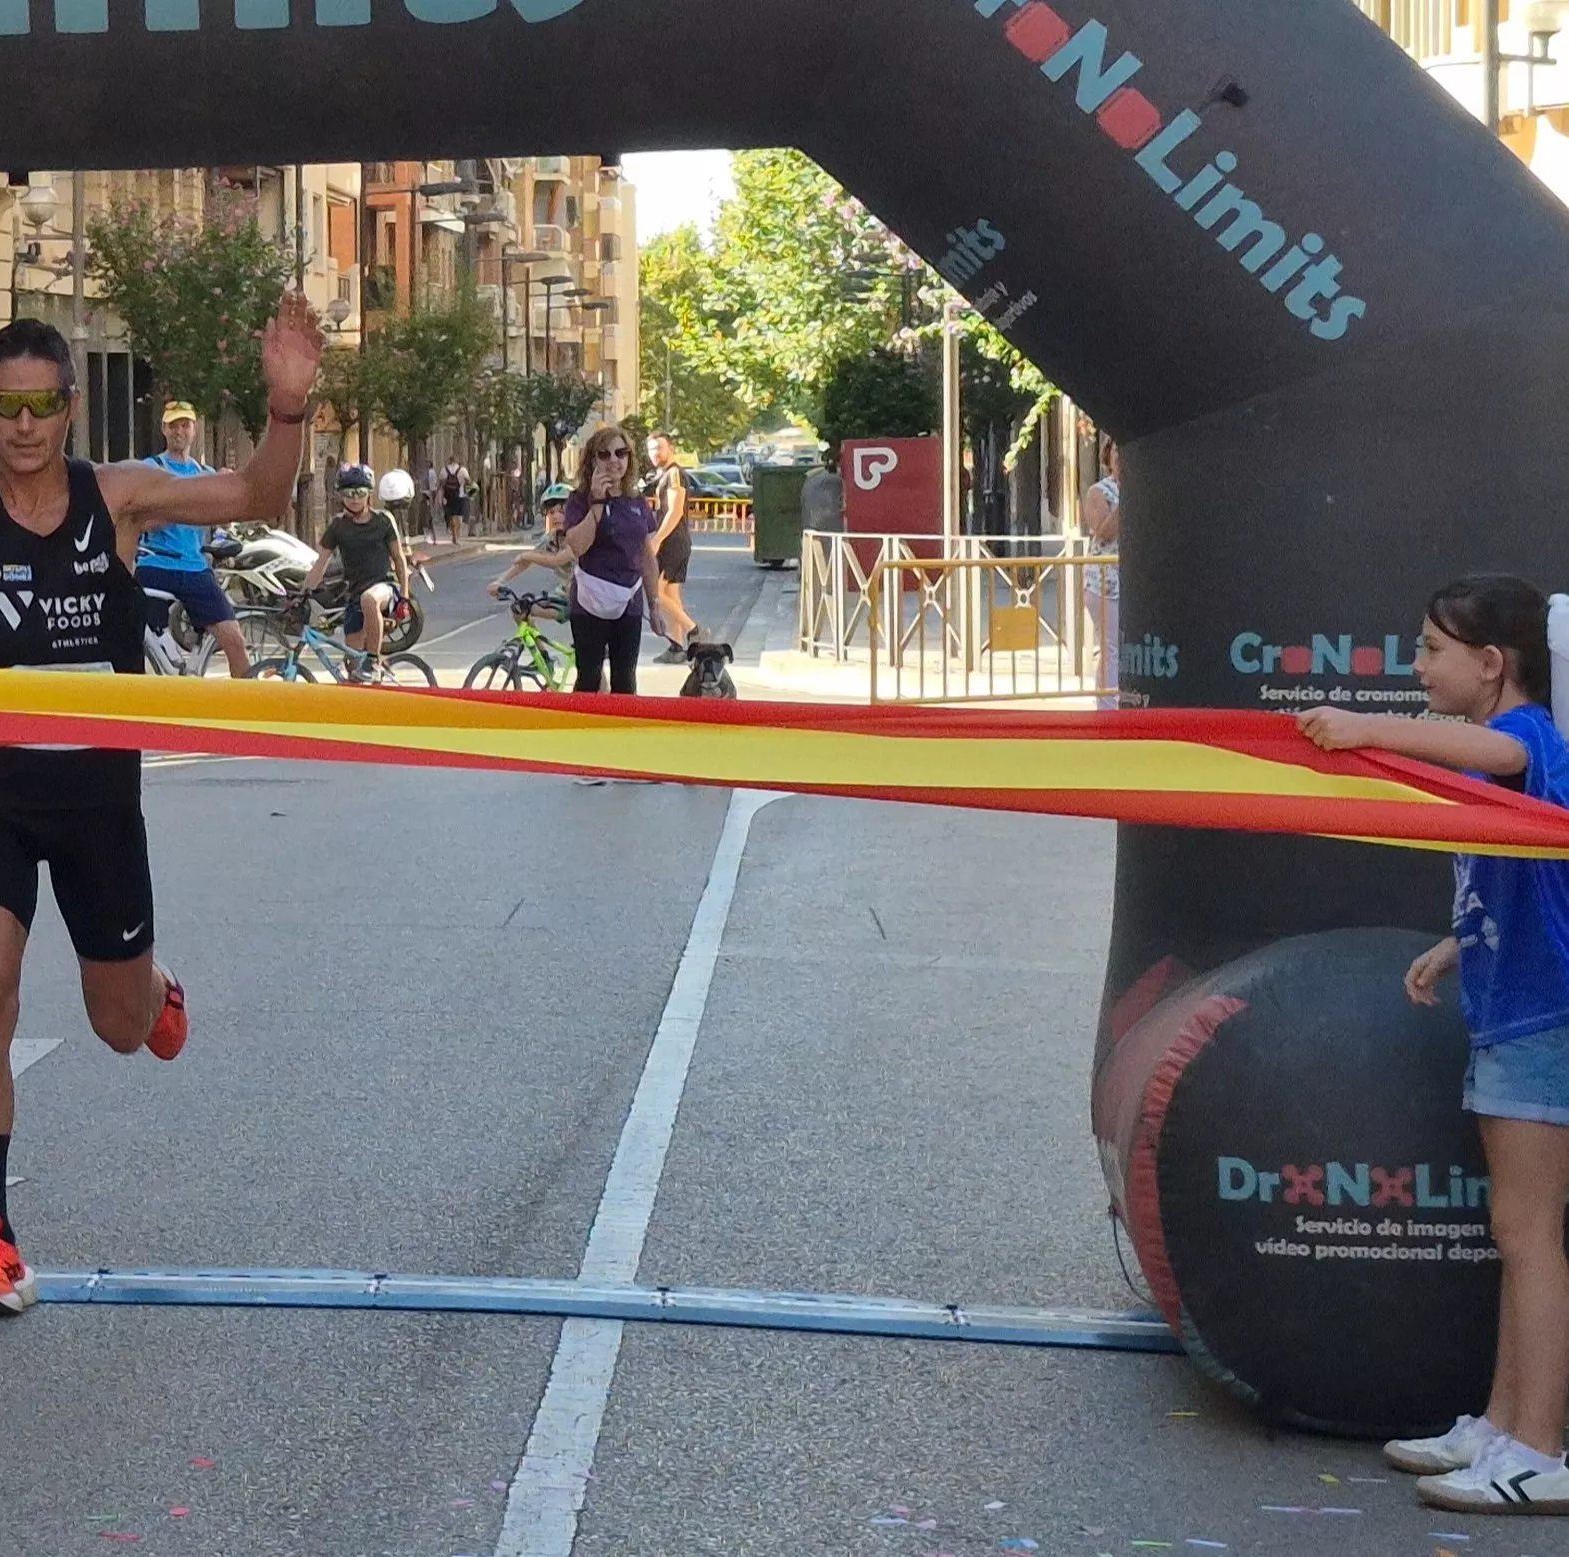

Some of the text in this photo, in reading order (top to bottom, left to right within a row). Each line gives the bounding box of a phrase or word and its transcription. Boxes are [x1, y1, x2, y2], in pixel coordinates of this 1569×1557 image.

[38, 593, 105, 615] VICKY
[47, 612, 101, 631] FOODS
[1258, 683, 1327, 701] Servicio
[1328, 685, 1352, 701] de
[1295, 1215, 1372, 1236] Servicio
[1407, 1218, 1485, 1240] imagen
